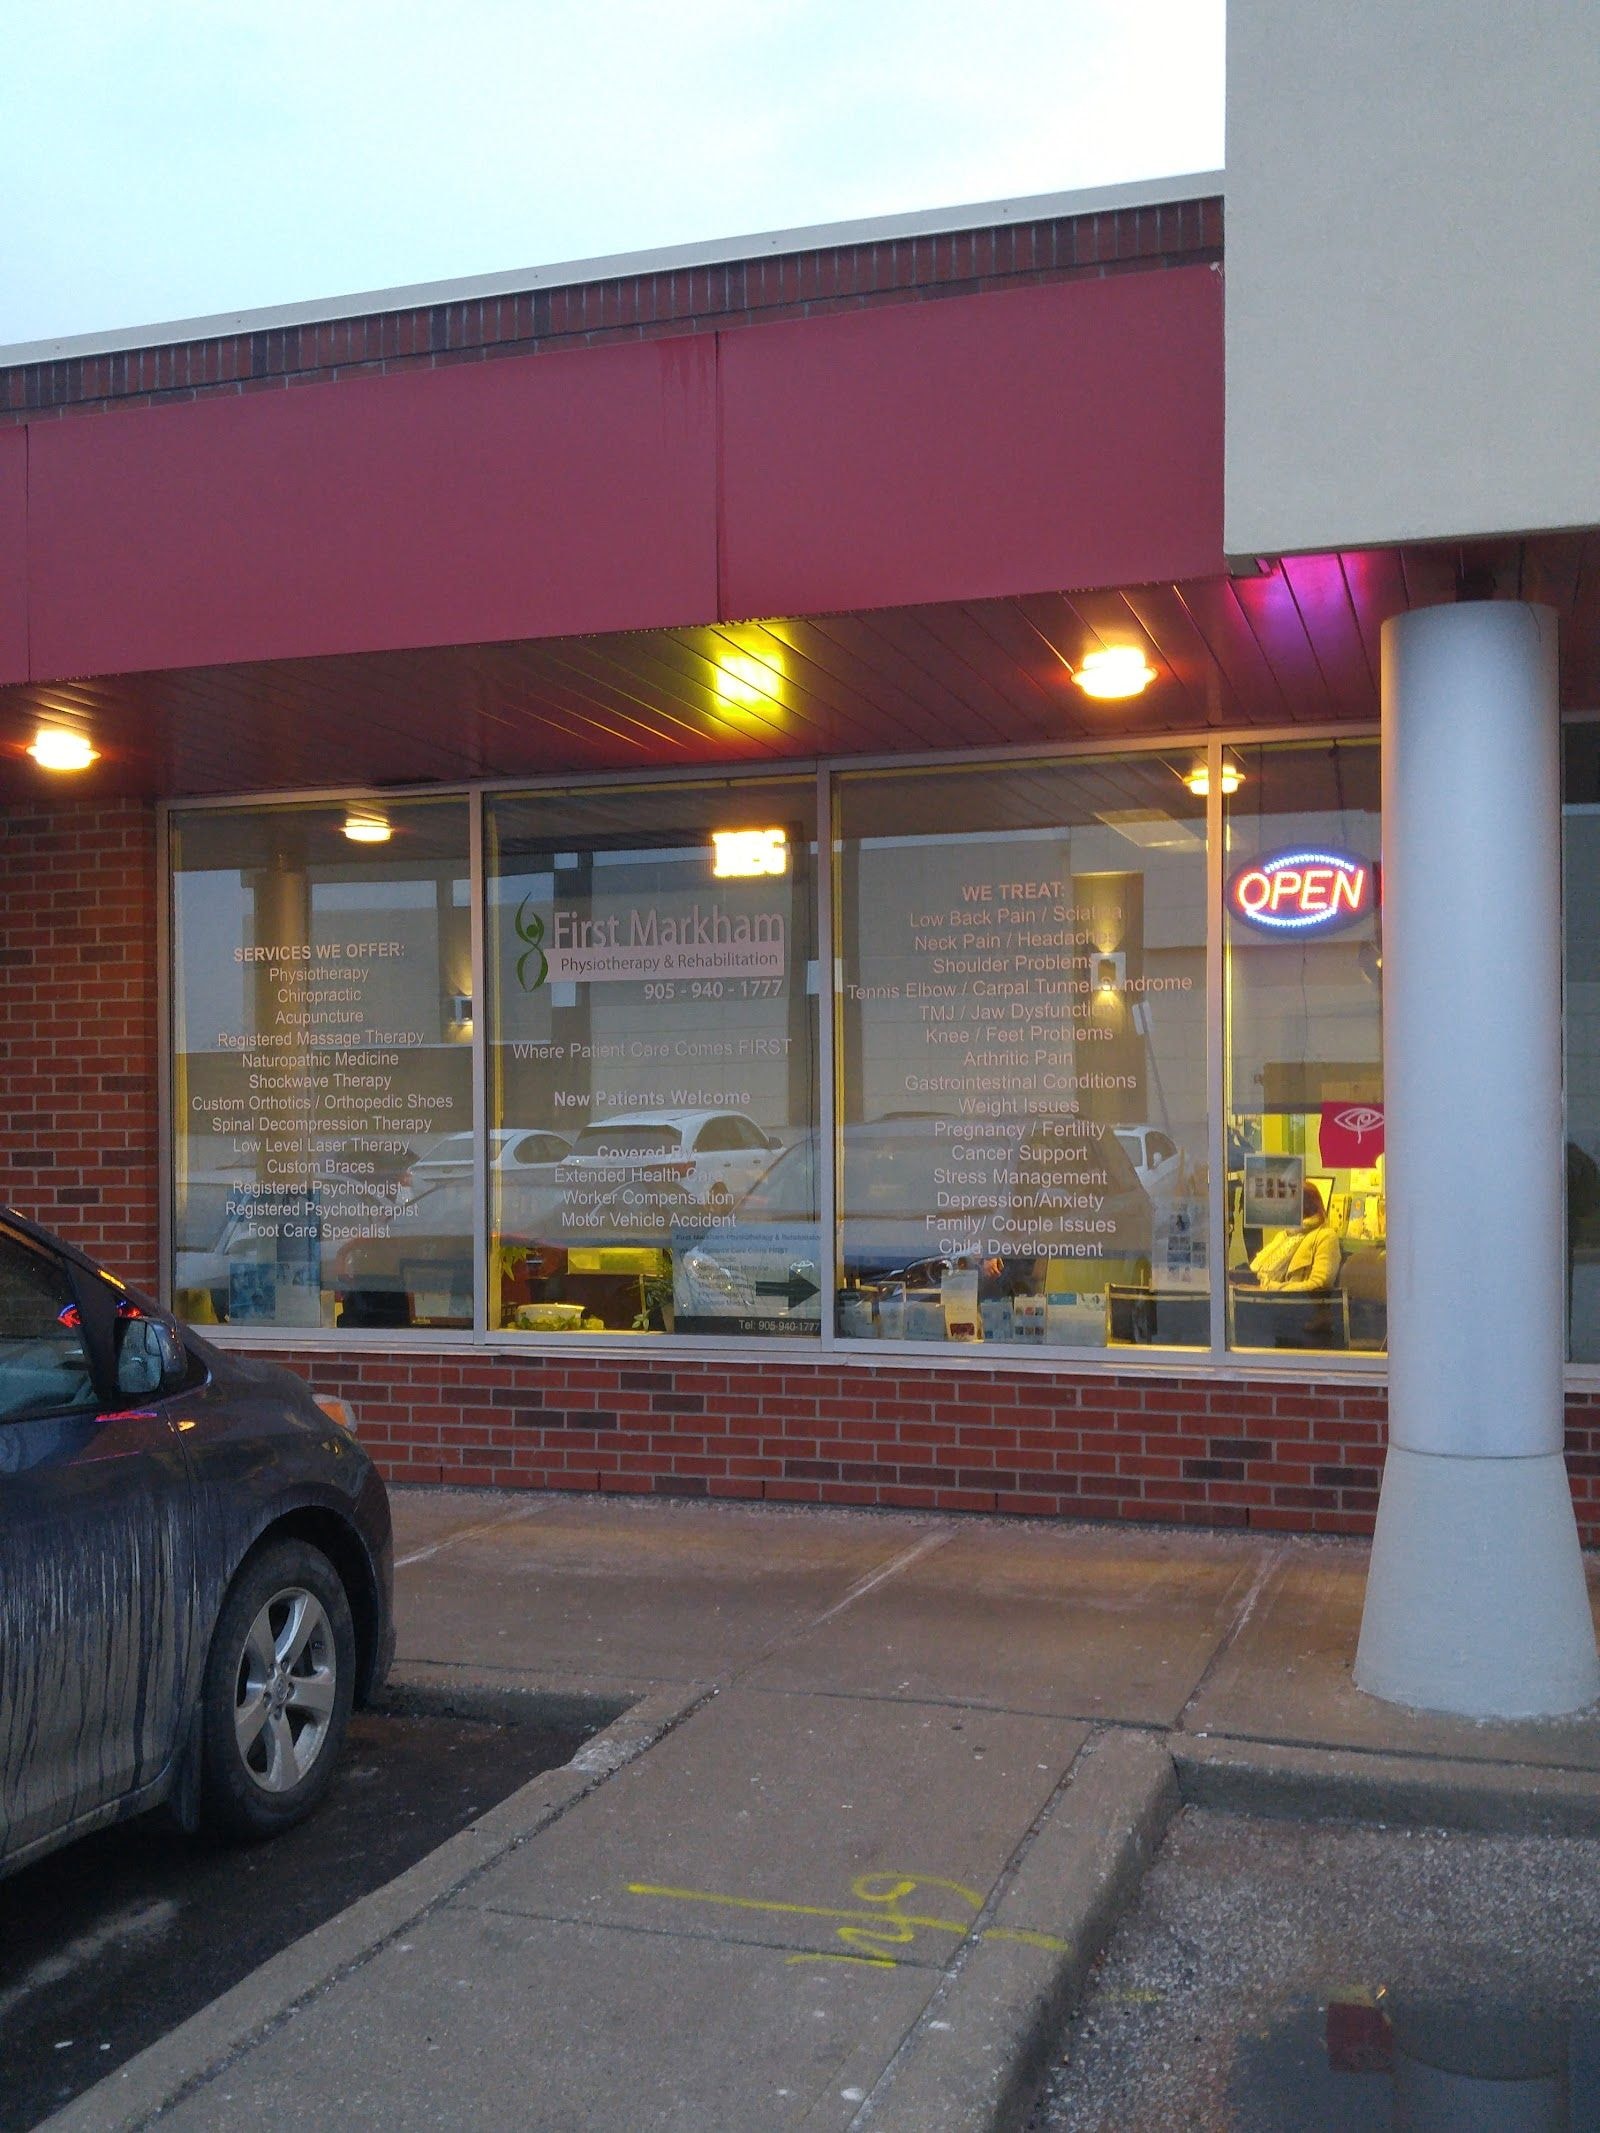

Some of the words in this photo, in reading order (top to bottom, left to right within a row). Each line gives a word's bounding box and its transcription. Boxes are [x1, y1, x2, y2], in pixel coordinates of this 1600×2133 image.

[963, 885, 992, 901] WE
[1000, 882, 1065, 900] TREAT:
[1238, 869, 1364, 912] OPEN
[553, 911, 620, 949] First
[630, 905, 785, 947] Markham
[910, 912, 943, 928] Low
[950, 910, 991, 926] Back
[997, 908, 1036, 925] Pain
[1040, 907, 1048, 923] /
[915, 934, 957, 950] Neck
[963, 933, 1001, 949] Pain
[1006, 932, 1013, 948] /
[234, 946, 311, 962] SERVICES
[316, 944, 341, 959] WE
[346, 942, 405, 957] OFFER:
[560, 955, 660, 975] Physiotherapy
[664, 954, 674, 968] &
[678, 952, 778, 968] Rehabilitation
[933, 957, 1009, 974] Shoulder
[1015, 955, 1095, 971] Problems
[270, 966, 369, 985] Physiotherapy
[277, 987, 362, 1005] Chiropractic
[644, 983, 675, 1000] 905
[691, 981, 724, 998] 940
[740, 980, 783, 997] 1777
[846, 984, 900, 1000] Tennis
[906, 981, 956, 998] Elbow
[961, 980, 968, 996] /
[972, 979, 1030, 999] Carpal
[1035, 977, 1094, 994] Tunnel
[1100, 974, 1193, 992] Sndrome
[275, 1009, 364, 1027] Acupuncture
[919, 1004, 955, 1021] TMJ
[959, 1003, 967, 1019] /
[971, 1003, 1005, 1020] Jaw
[218, 1031, 292, 1051] Registered
[296, 1031, 360, 1047] Massage
[365, 1029, 425, 1047] Therapy
[926, 1028, 969, 1043] Knee
[975, 1027, 982, 1043] /
[986, 1026, 1024, 1042] Feet
[1030, 1025, 1113, 1041] Problems
[512, 1043, 564, 1059] Where
[570, 1042, 626, 1059] Patient
[630, 1041, 670, 1057] Care
[675, 1040, 733, 1056] Comes
[738, 1038, 792, 1056] FIRST
[964, 1050, 1029, 1066] Arthritic
[1035, 1050, 1074, 1065] Pain
[242, 1052, 331, 1071] Naturopathic
[335, 1051, 399, 1066] Medicine
[249, 1074, 329, 1089] Shockwave
[332, 1073, 392, 1091] Therapy
[905, 1074, 1037, 1092] Gastrointestinal
[1043, 1073, 1137, 1089] Conditions
[192, 1096, 244, 1111] Custom
[249, 1095, 311, 1110] Orthotics
[315, 1095, 321, 1110] /
[324, 1095, 402, 1113] Orthopedic
[407, 1094, 454, 1109] Shoes
[554, 1092, 591, 1107] New
[595, 1091, 664, 1106] Patients
[670, 1090, 751, 1105] Welcome
[959, 1097, 1017, 1117] Weight
[1023, 1098, 1080, 1113] Issues
[212, 1117, 255, 1133] Spinal
[259, 1117, 368, 1135] Decompression
[372, 1116, 432, 1134] Therapy
[935, 1122, 1025, 1141] Pregnancy
[1030, 1122, 1037, 1138] /
[1042, 1121, 1105, 1140] Fertility
[233, 1139, 261, 1153] Low
[266, 1138, 303, 1152] Level
[307, 1138, 347, 1152] Laser
[351, 1138, 410, 1156] Therapy
[597, 1145, 665, 1159] Covered
[952, 1145, 1013, 1161] Cancer
[1019, 1145, 1088, 1165] Support
[267, 1160, 321, 1174] Custom
[325, 1160, 375, 1173] Braces
[555, 1168, 627, 1183] Extended
[631, 1168, 681, 1183] Health
[934, 1168, 987, 1184] Stress
[993, 1168, 1108, 1188] Management
[233, 1181, 307, 1198] Registered
[312, 1181, 402, 1198] Psychologist
[563, 1191, 618, 1205] Worker
[622, 1190, 734, 1209] Compensation
[937, 1192, 1104, 1210] Depression/Anxiety
[226, 1202, 300, 1218] Registered
[305, 1202, 419, 1219] Psychotherapist
[562, 1213, 605, 1227] Motor
[609, 1213, 665, 1227] Vehicle
[669, 1213, 737, 1227] Accident
[248, 1223, 279, 1237] Foot
[283, 1223, 317, 1237] Care
[322, 1223, 391, 1241] Specialist
[992, 1216, 1054, 1236] Couple
[1059, 1216, 1116, 1233] Issues
[939, 1239, 982, 1255] Child
[987, 1239, 1103, 1260] Development
[759, 1321, 819, 1331] 905-940-1777
